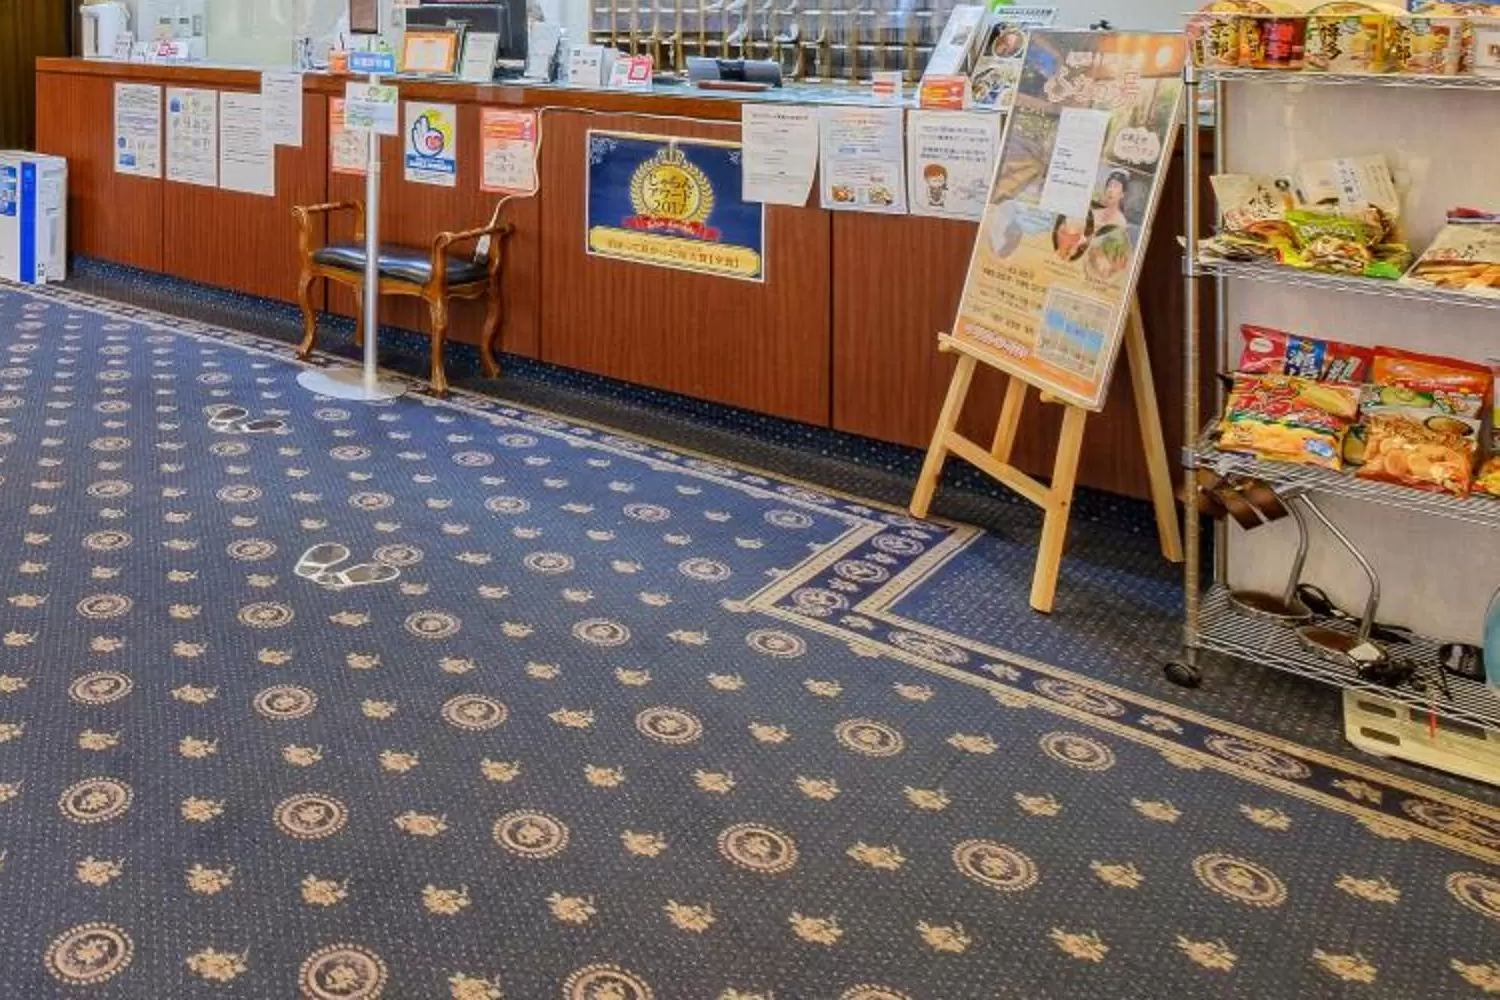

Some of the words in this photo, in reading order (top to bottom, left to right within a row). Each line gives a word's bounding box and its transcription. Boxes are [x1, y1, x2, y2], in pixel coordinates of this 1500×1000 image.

[649, 173, 694, 190] じゃらん
[648, 187, 693, 205] アワード
[653, 200, 688, 215] 2017
